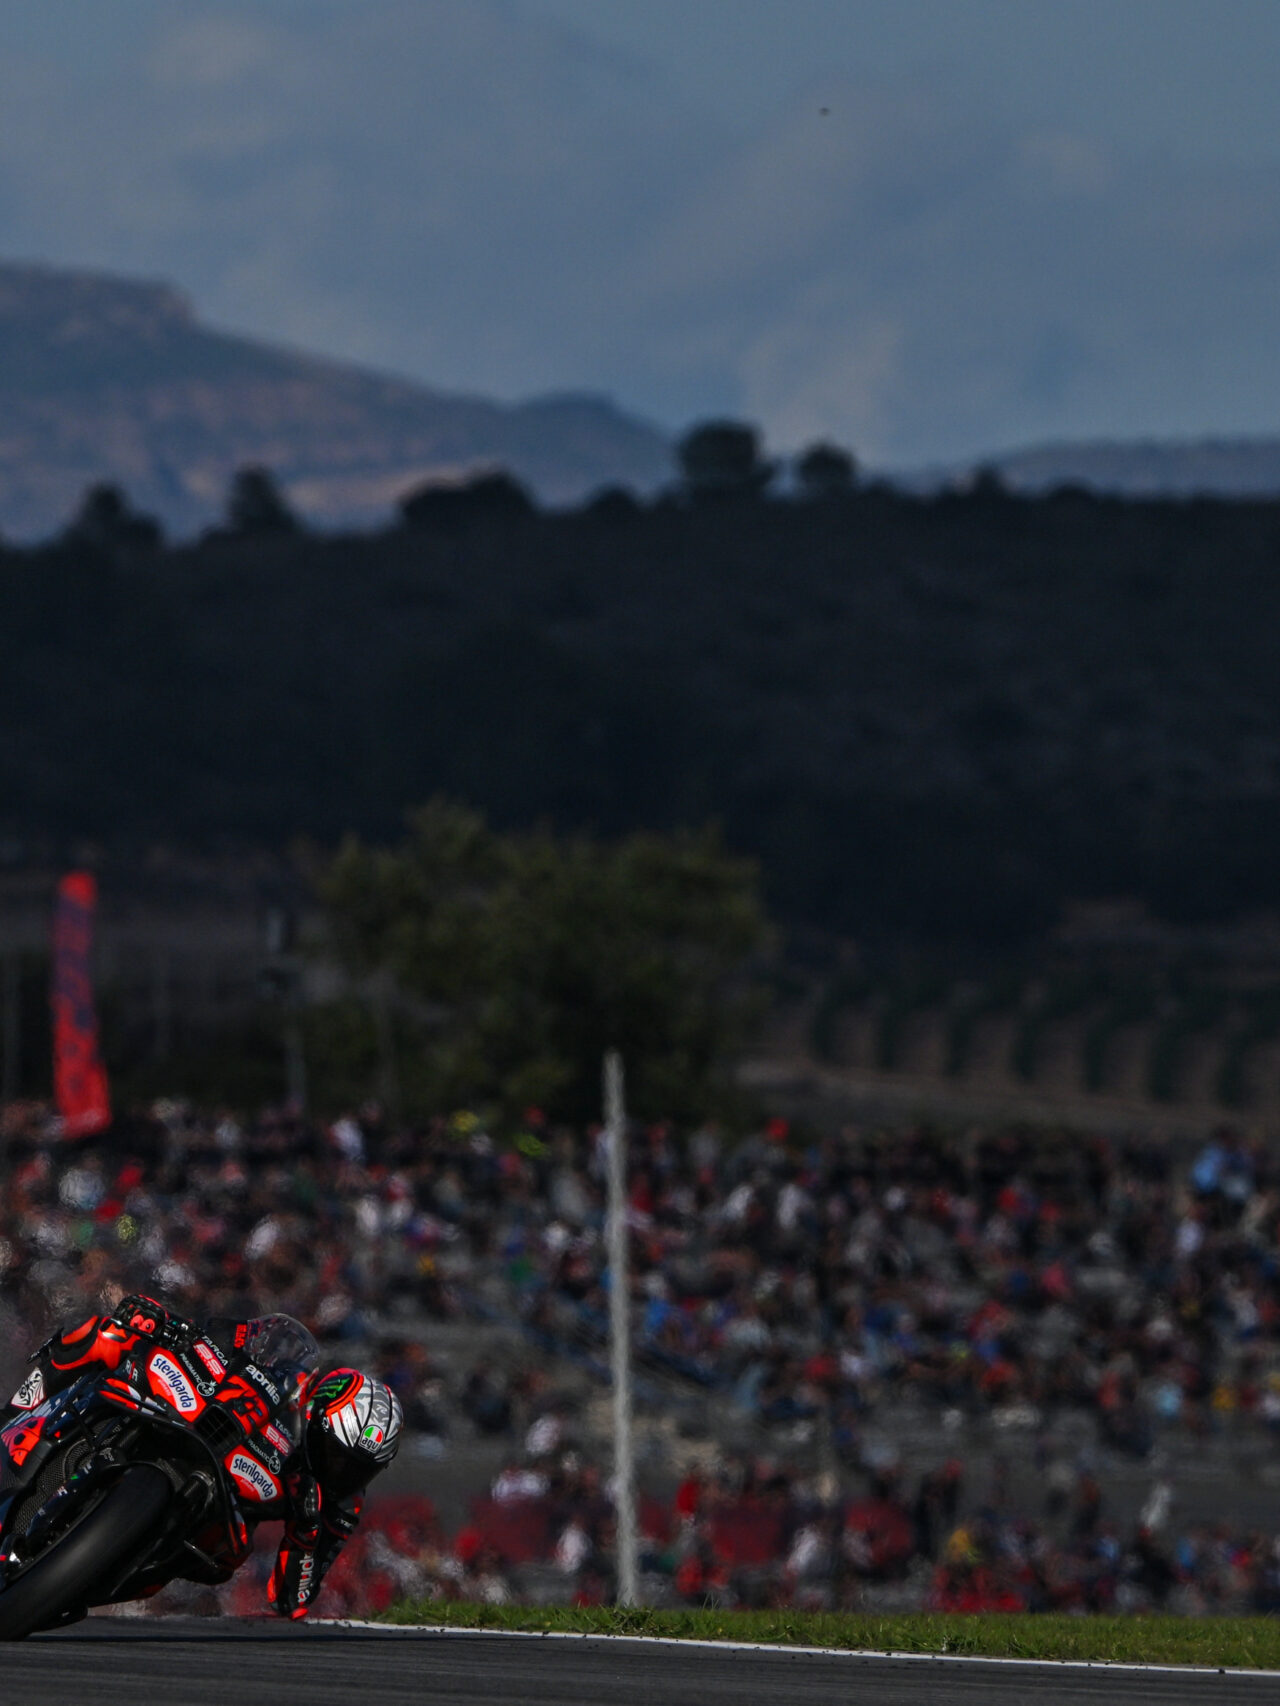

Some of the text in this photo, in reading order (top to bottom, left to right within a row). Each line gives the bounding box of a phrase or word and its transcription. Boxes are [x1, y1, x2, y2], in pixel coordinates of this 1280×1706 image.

[154, 1358, 194, 1408] sterilgarda
[245, 1364, 280, 1406] aprilia
[361, 1437, 378, 1450] agv
[233, 1457, 273, 1498] sterilgarda
